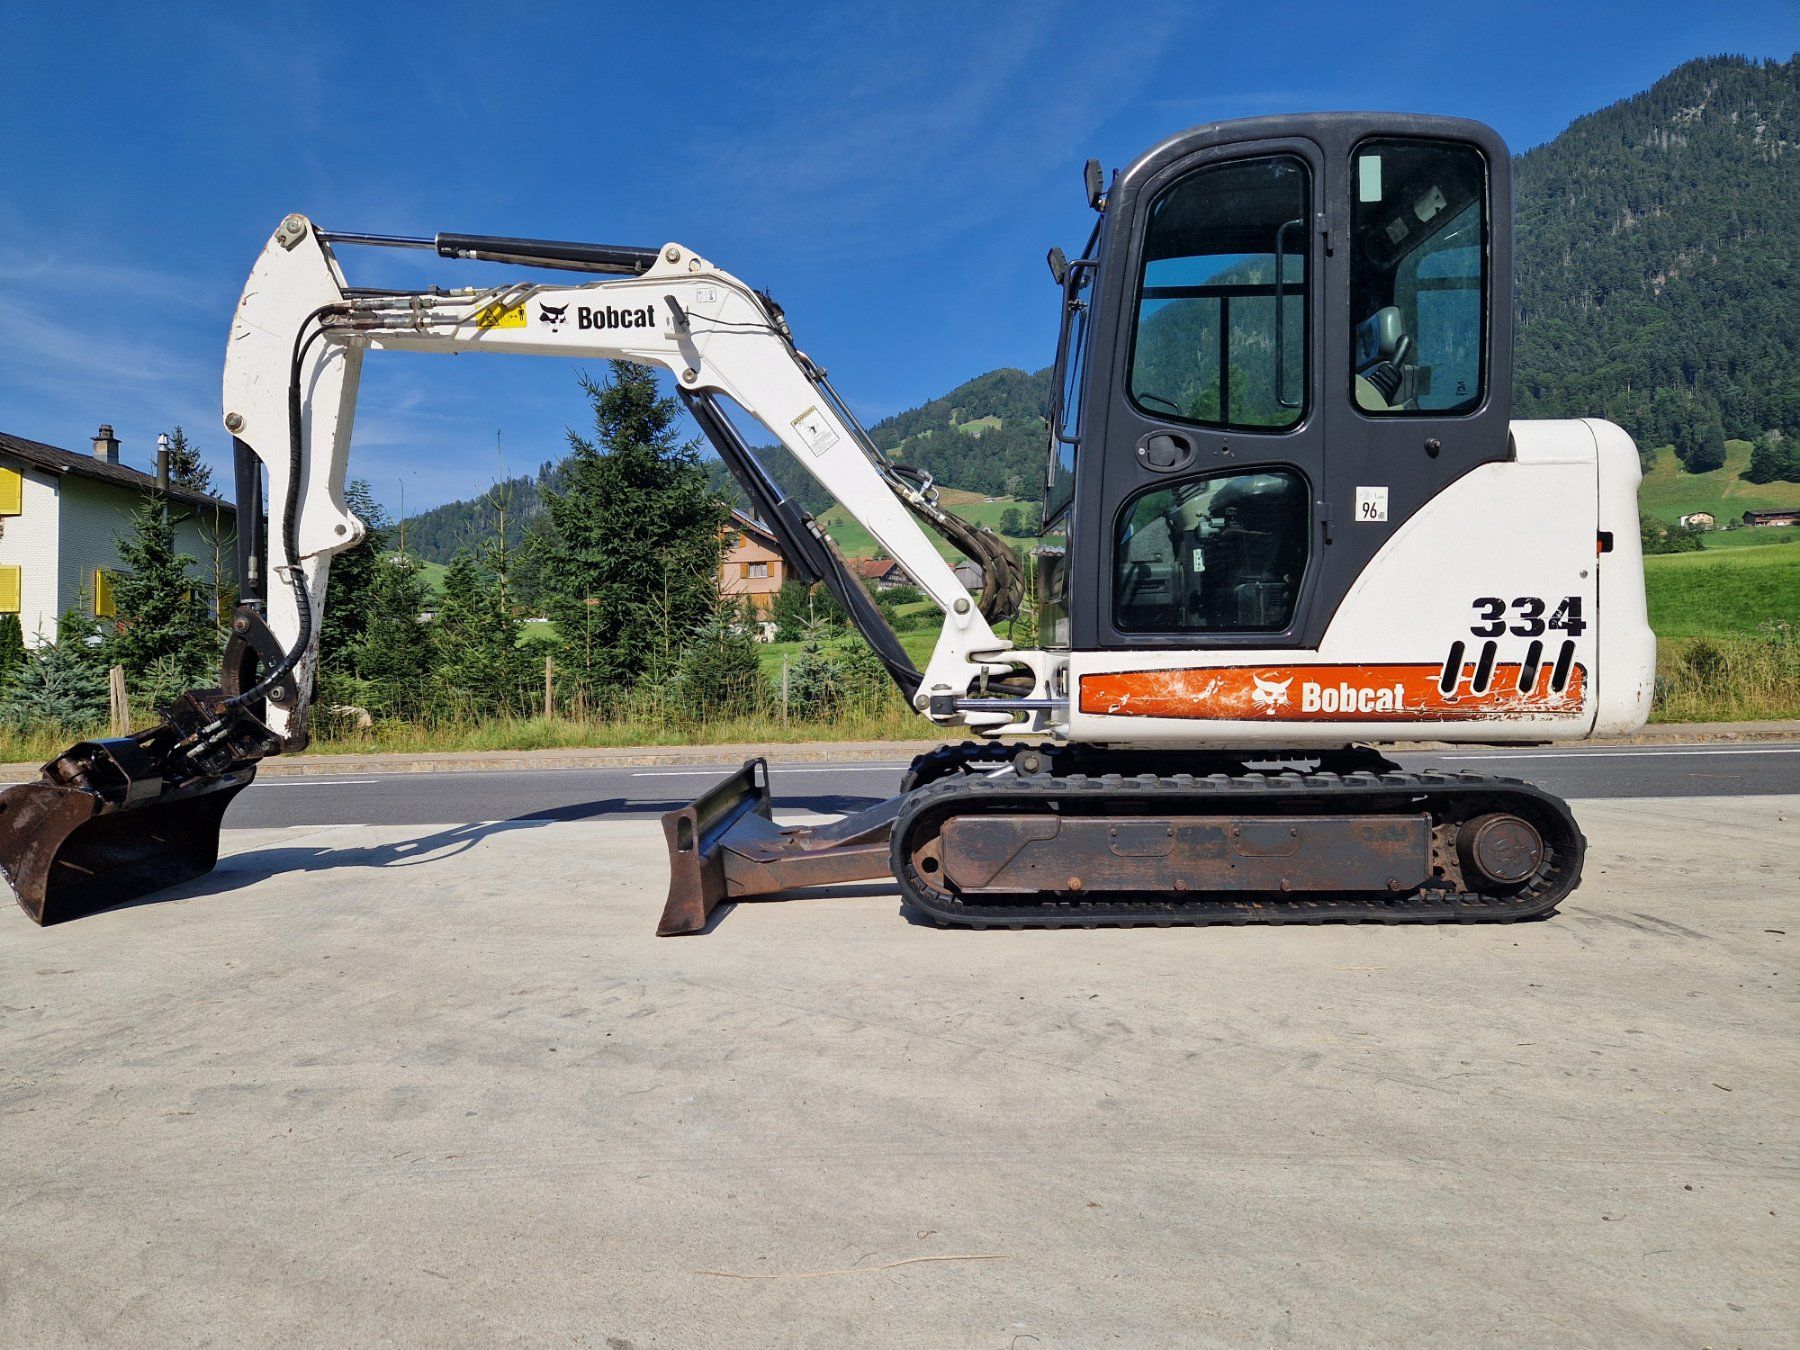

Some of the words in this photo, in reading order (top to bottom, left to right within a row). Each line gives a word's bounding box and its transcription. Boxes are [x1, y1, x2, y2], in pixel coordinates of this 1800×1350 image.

[578, 305, 655, 329] Bobcat
[1362, 502, 1377, 518] 96
[1470, 597, 1586, 637] 334
[1302, 682, 1404, 712] Bobcat
